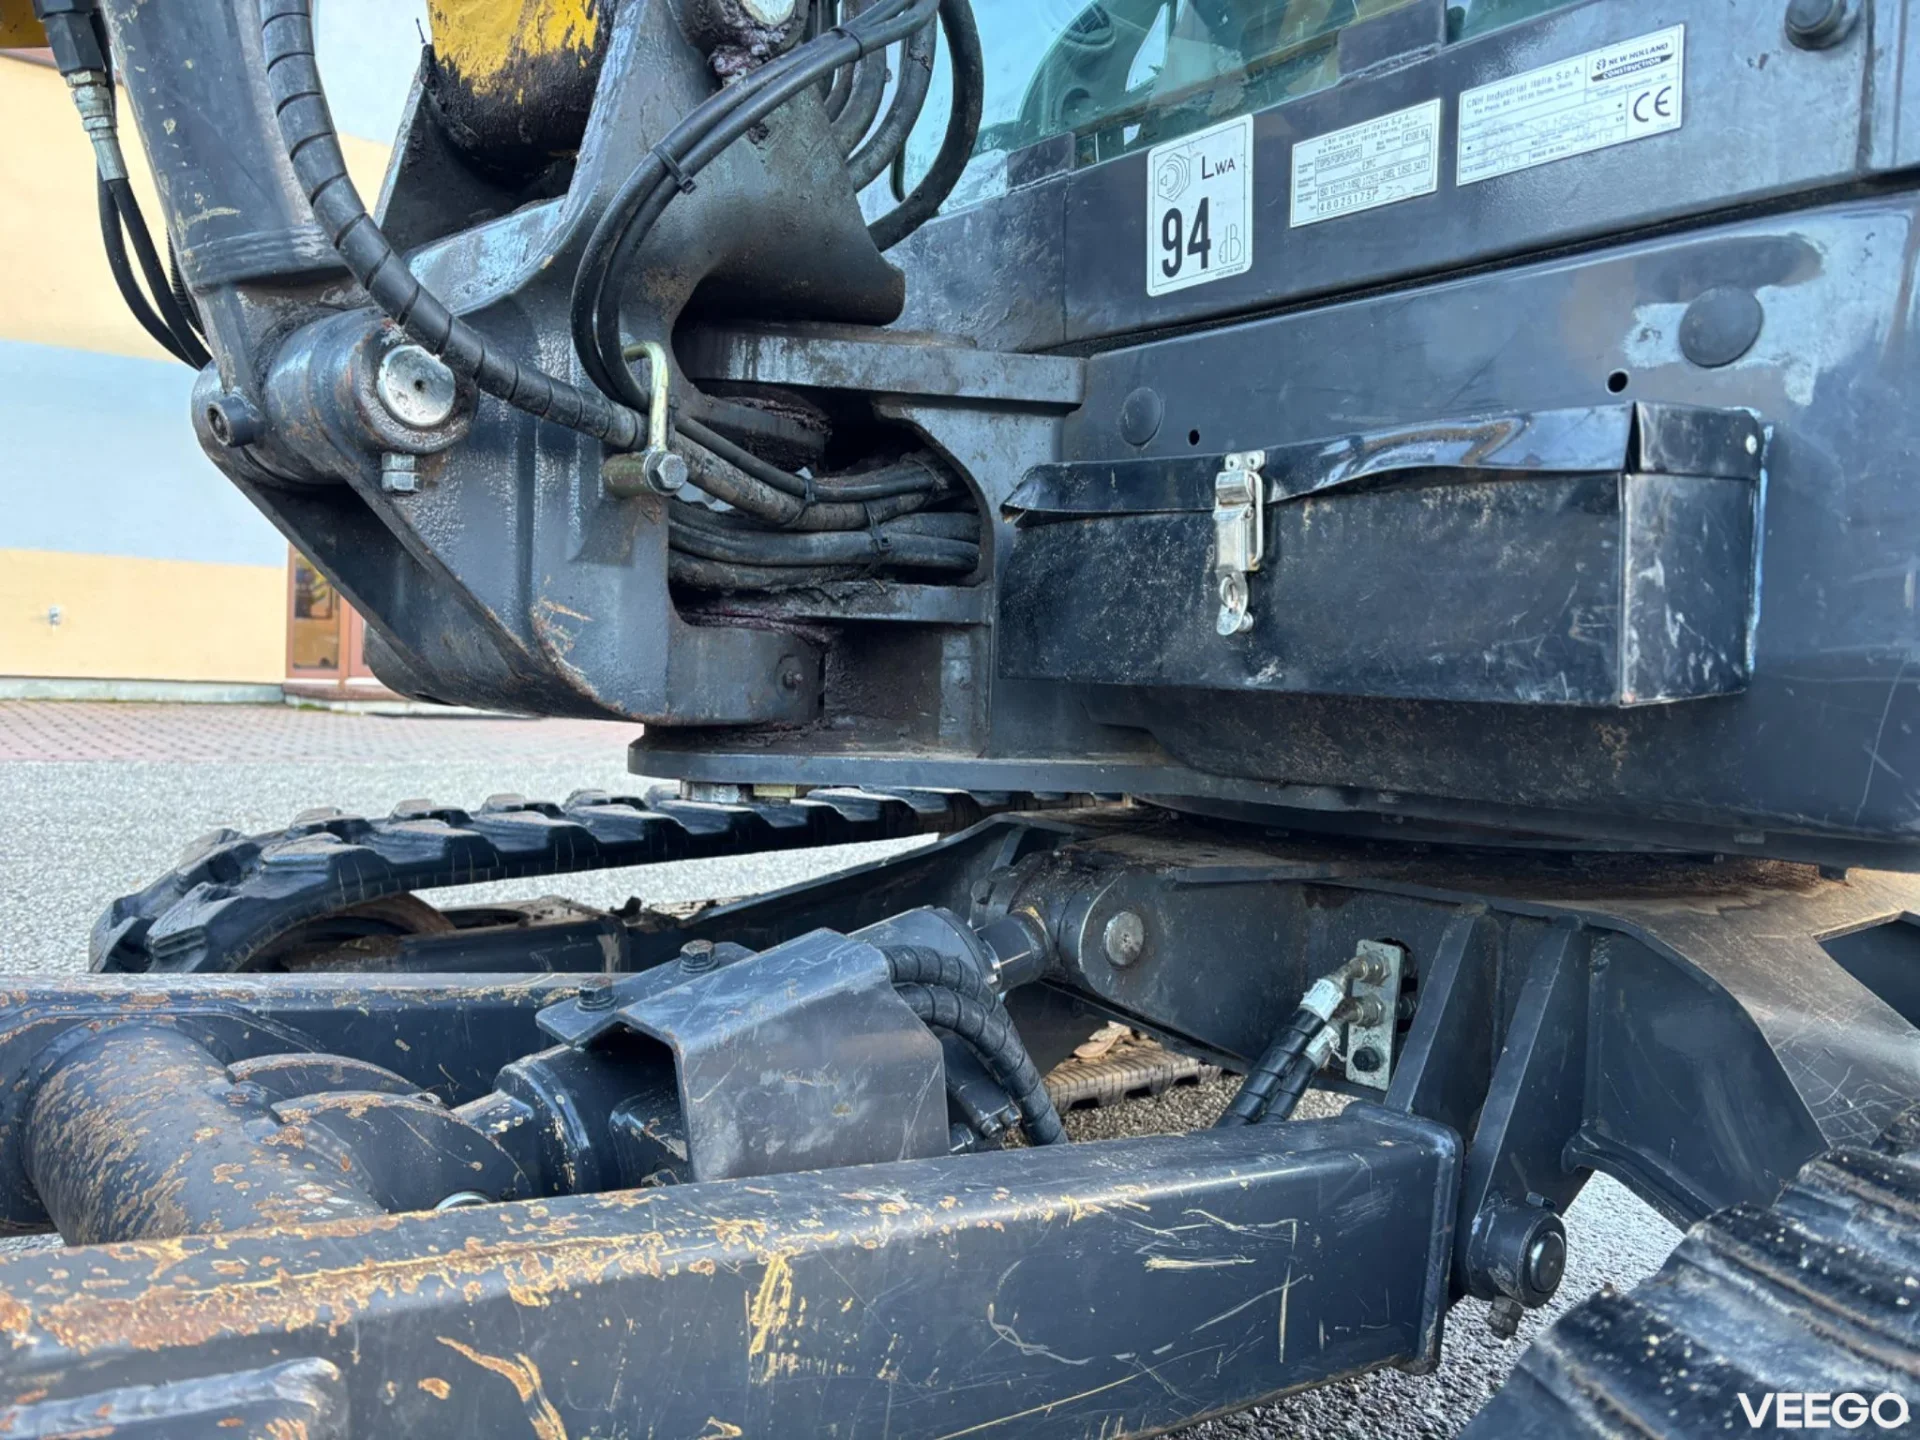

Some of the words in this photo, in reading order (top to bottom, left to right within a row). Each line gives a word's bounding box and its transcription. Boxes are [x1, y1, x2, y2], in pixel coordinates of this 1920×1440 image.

[1608, 54, 1628, 66] NEW
[1633, 85, 1672, 123] CE
[1161, 197, 1212, 278] 94
[1218, 223, 1242, 264] dB
